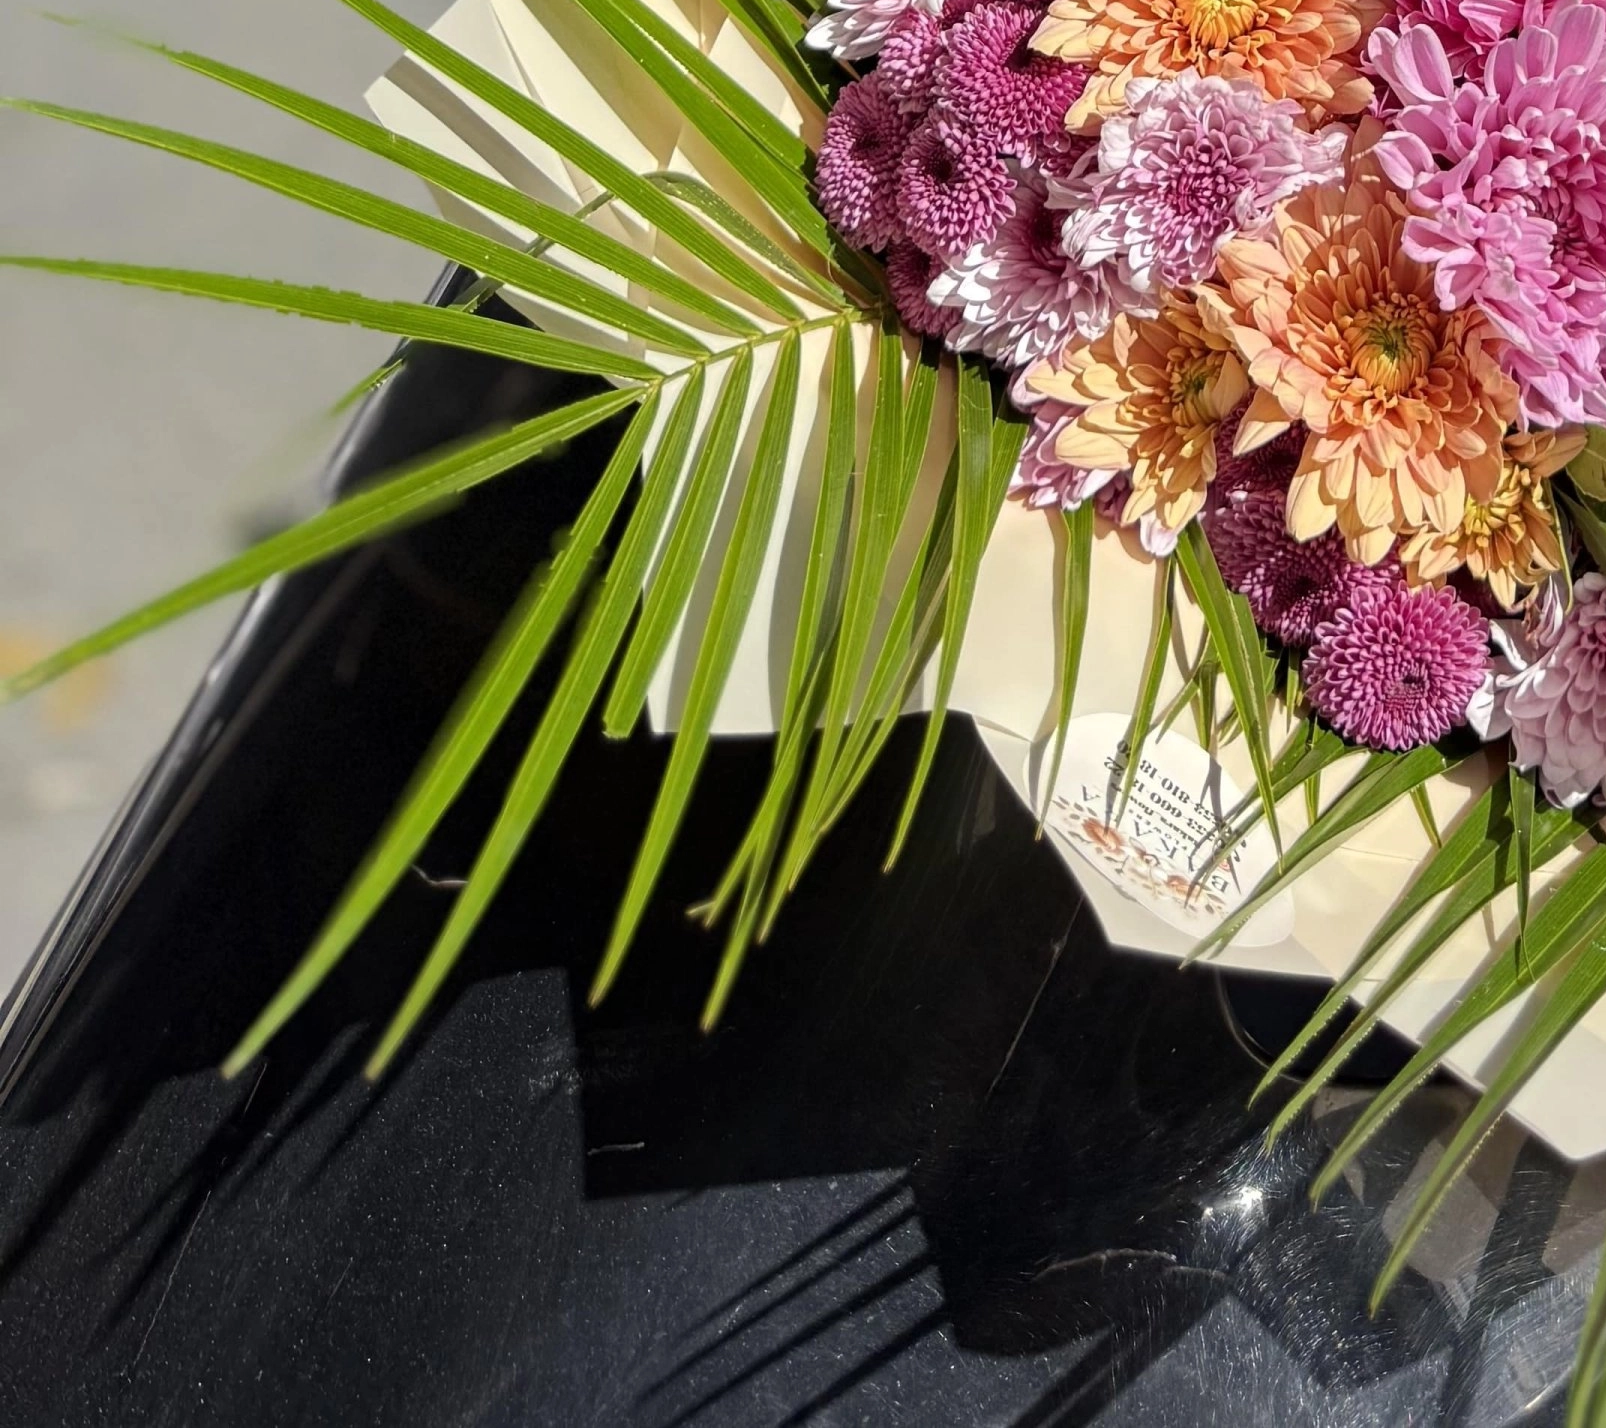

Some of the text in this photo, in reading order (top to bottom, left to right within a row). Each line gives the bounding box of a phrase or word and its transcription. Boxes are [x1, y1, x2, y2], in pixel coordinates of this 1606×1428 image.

[1103, 756, 1225, 849] 0553-660-122
[1109, 781, 1201, 849] bakara_flowrs
[1116, 739, 1232, 837] 53-810-180
